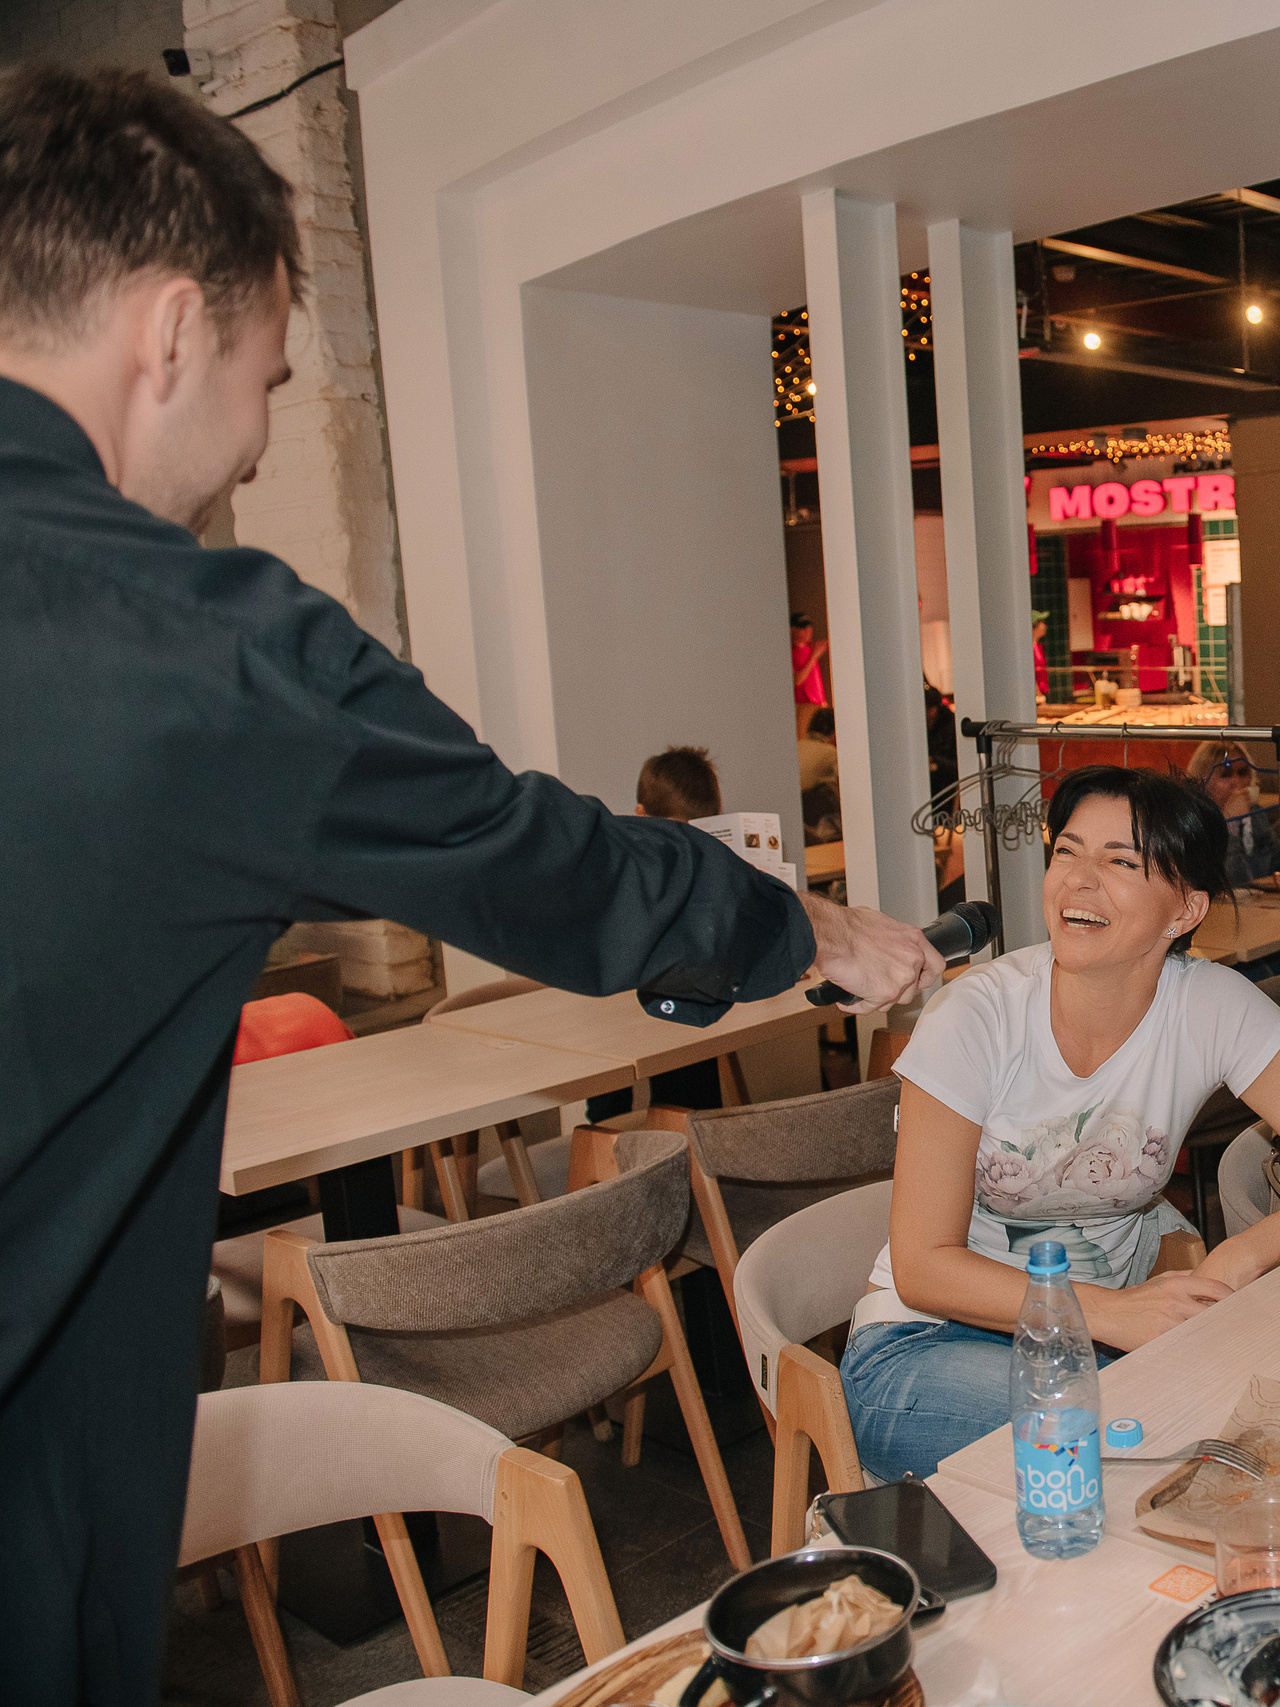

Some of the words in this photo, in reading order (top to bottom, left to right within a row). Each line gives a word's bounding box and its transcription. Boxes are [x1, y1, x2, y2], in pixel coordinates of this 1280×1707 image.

[1049, 474, 1236, 522] MOSTR
[1027, 1464, 1085, 1489] bon
[1029, 1478, 1098, 1512] aqua
